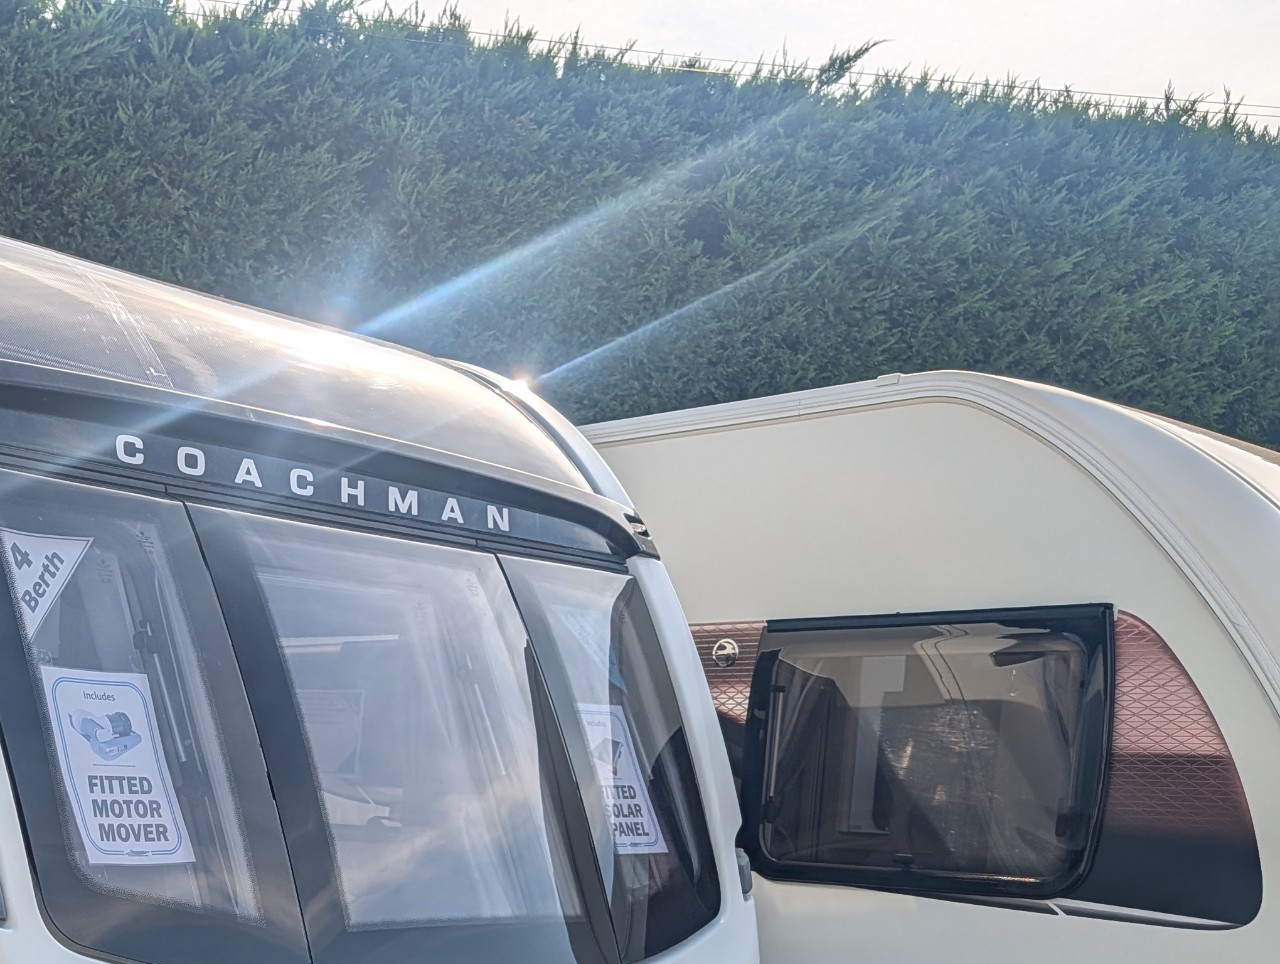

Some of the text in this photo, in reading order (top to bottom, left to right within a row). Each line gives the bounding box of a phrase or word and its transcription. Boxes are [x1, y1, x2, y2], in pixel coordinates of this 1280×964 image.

[116, 434, 510, 532] COACHMAN
[10, 541, 33, 571] 4
[20, 551, 65, 614] Berth
[83, 690, 116, 702] Includes
[87, 774, 153, 795] FITTED
[603, 784, 637, 800] ITTED
[91, 798, 163, 819] MOTOR
[98, 822, 170, 843] MOVER
